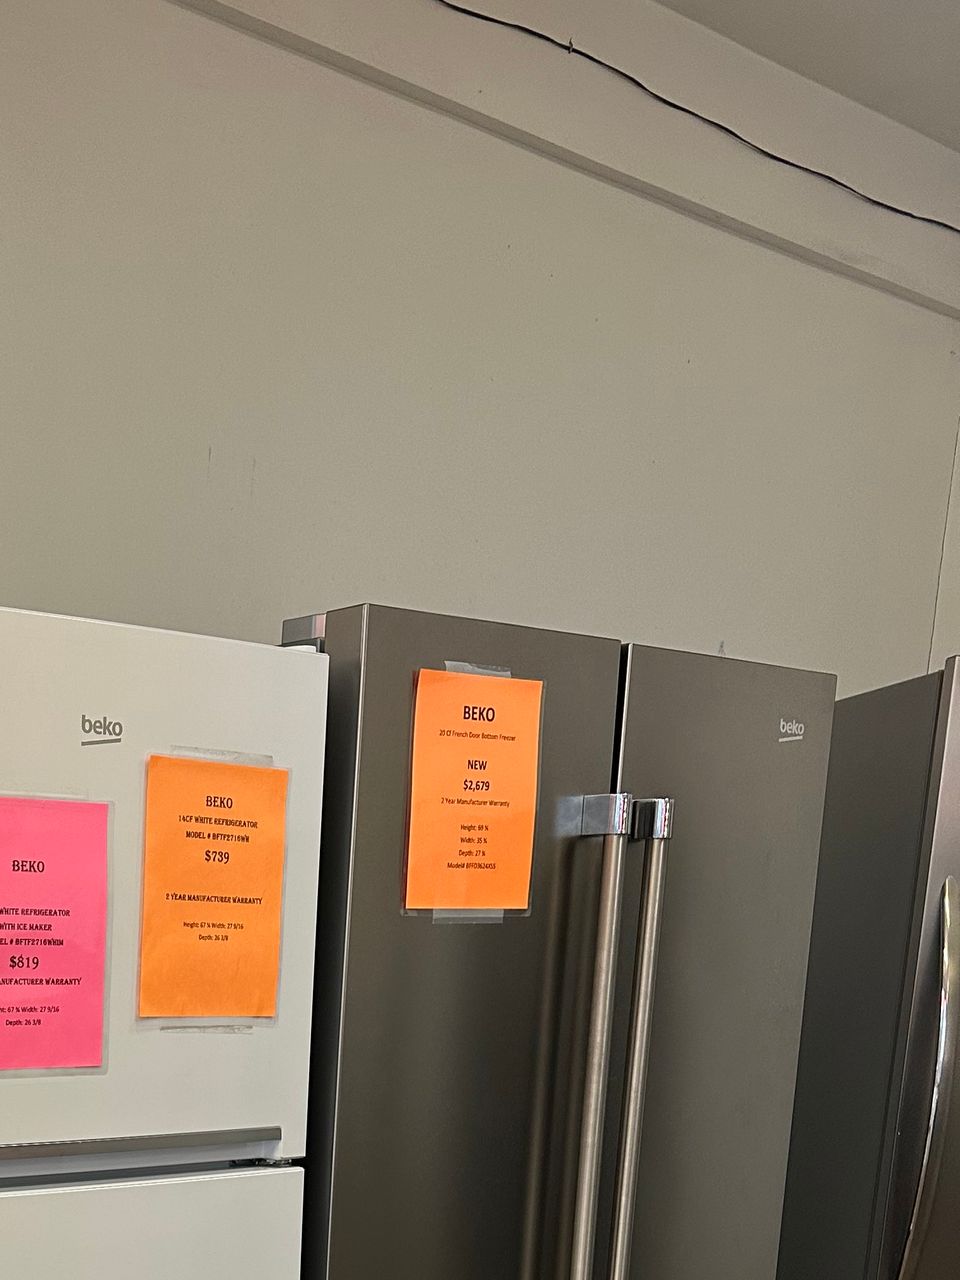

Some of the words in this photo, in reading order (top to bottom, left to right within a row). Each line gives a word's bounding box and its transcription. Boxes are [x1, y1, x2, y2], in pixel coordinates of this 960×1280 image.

[463, 705, 495, 722] BEKO
[81, 714, 123, 736] beko
[780, 718, 804, 735] beko
[467, 759, 487, 770] NEW
[463, 779, 490, 792] $2,679
[205, 795, 233, 809] BEKO
[194, 815, 213, 824] WHITE
[214, 817, 258, 829] REFRIGERATOR
[185, 831, 206, 839] MODEL
[205, 849, 230, 864] $739
[11, 860, 45, 873] BEKO
[171, 892, 186, 901] YEAR
[187, 893, 231, 903] MANUFACTURER
[232, 896, 263, 904] WARRANTY
[0, 907, 20, 915] WHITE
[21, 908, 70, 916] REFRIGERATOR
[0, 922, 16, 930] WITH
[17, 923, 27, 931] ICE
[9, 954, 39, 970] $819
[45, 977, 82, 985] WARRANTY
